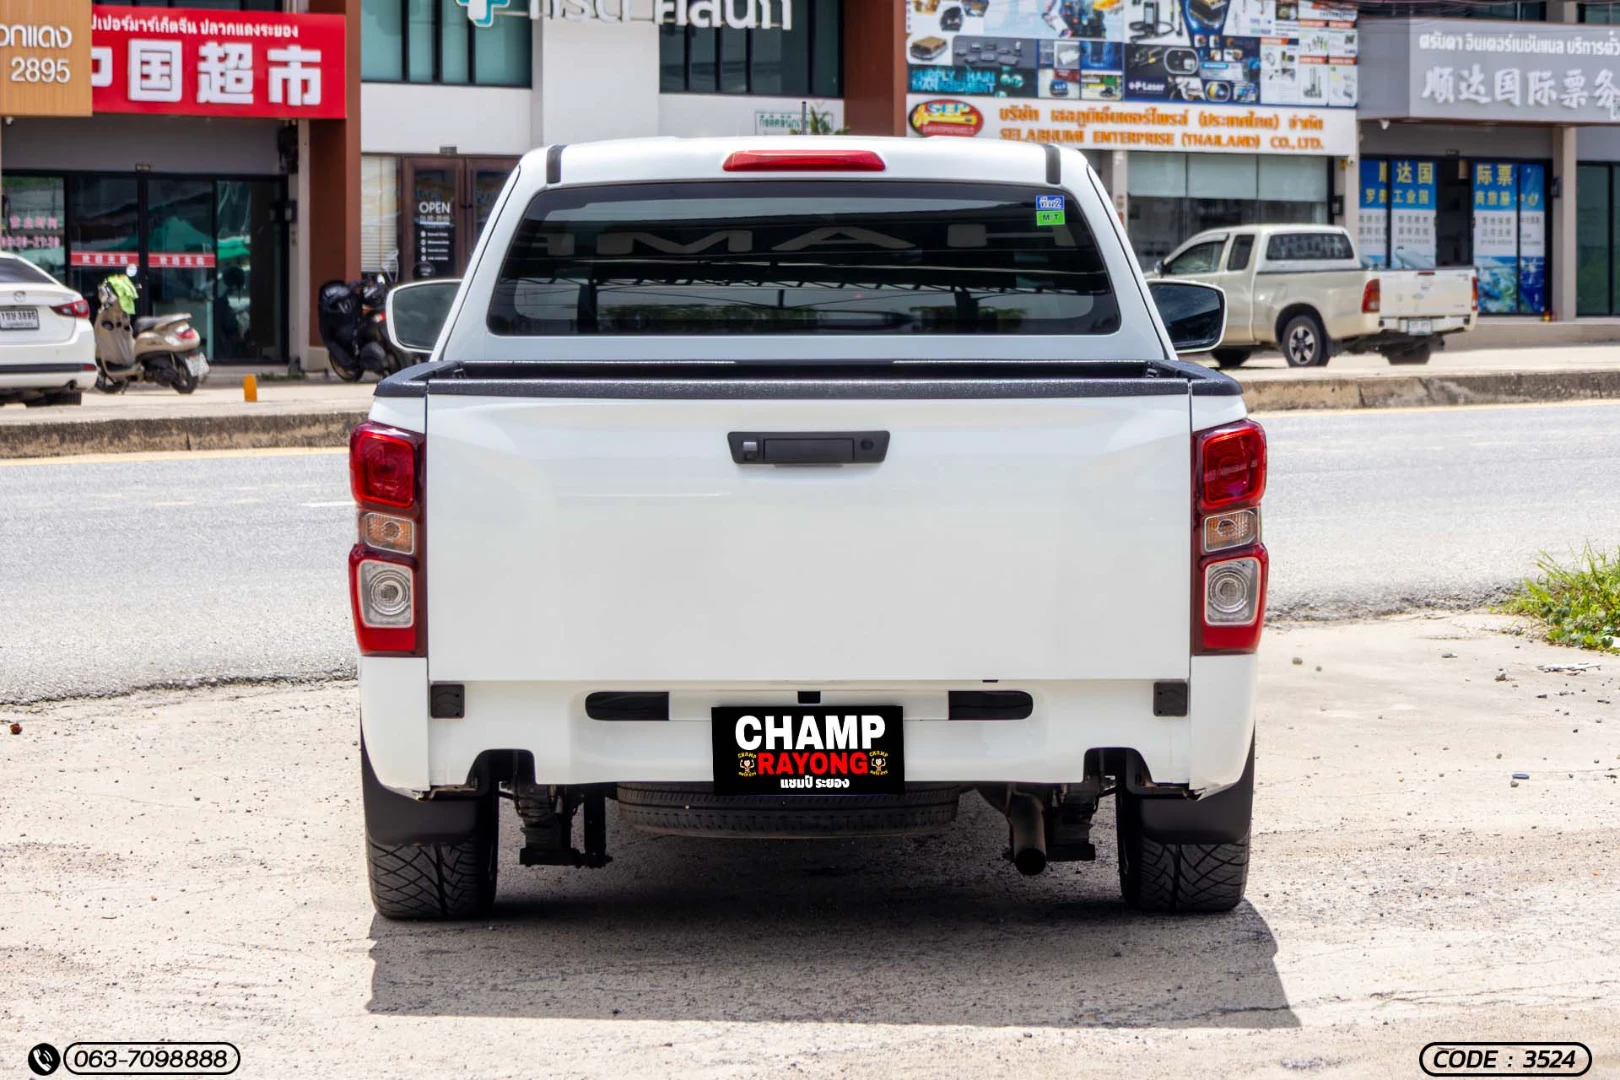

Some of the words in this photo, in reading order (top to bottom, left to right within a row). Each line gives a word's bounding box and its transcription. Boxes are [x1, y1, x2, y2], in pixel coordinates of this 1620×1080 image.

[11, 56, 71, 83] 2895
[999, 104, 1039, 121] บริษัท
[1093, 130, 1174, 146] ENTERPRISE
[1181, 133, 1260, 149] (THAILAND)
[419, 201, 450, 214] OPEN
